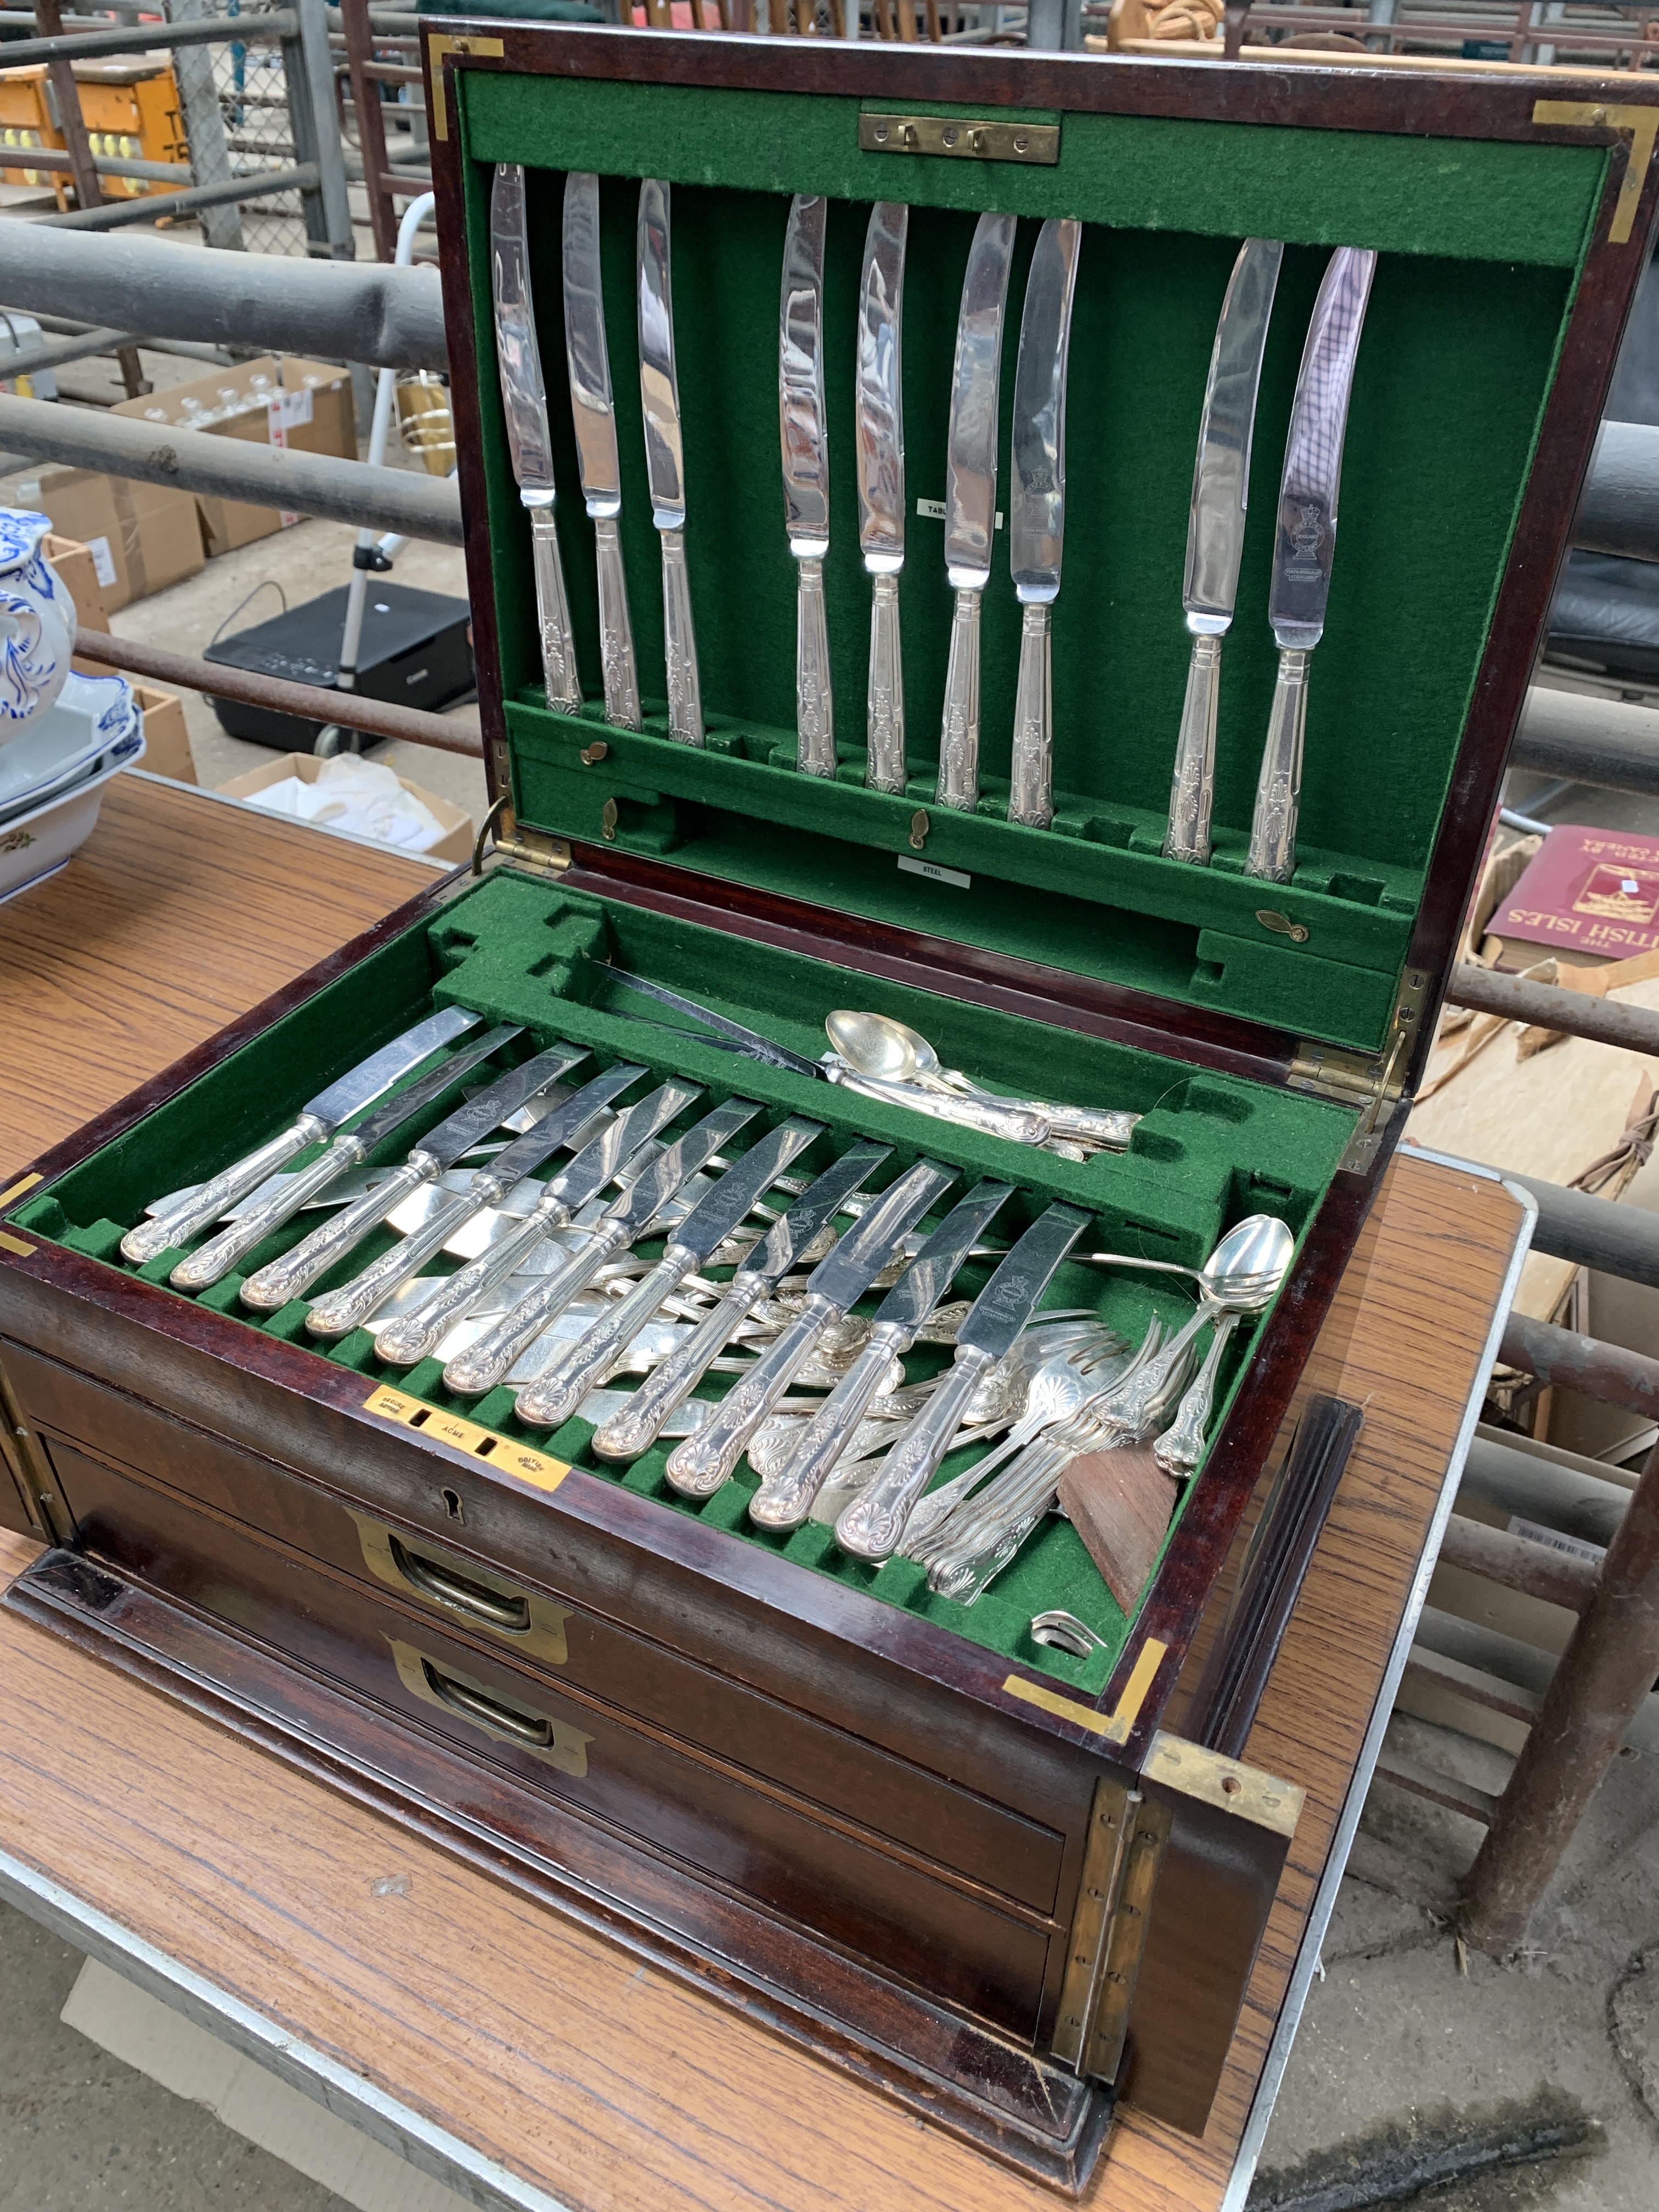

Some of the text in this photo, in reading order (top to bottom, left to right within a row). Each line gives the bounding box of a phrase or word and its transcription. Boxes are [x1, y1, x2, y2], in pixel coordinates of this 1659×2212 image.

[1293, 521, 1323, 536] SHEFFIELD
[1294, 542, 1318, 551] CUTLERY
[923, 866, 942, 876] STEEL
[1507, 909, 1659, 949] ITISH ISLES
[1579, 936, 1612, 950] THE
[379, 1402, 399, 1414] ACTION
[382, 1397, 405, 1409] SECURE
[442, 1426, 465, 1439] ACME
[518, 1457, 544, 1471] BRITISH
